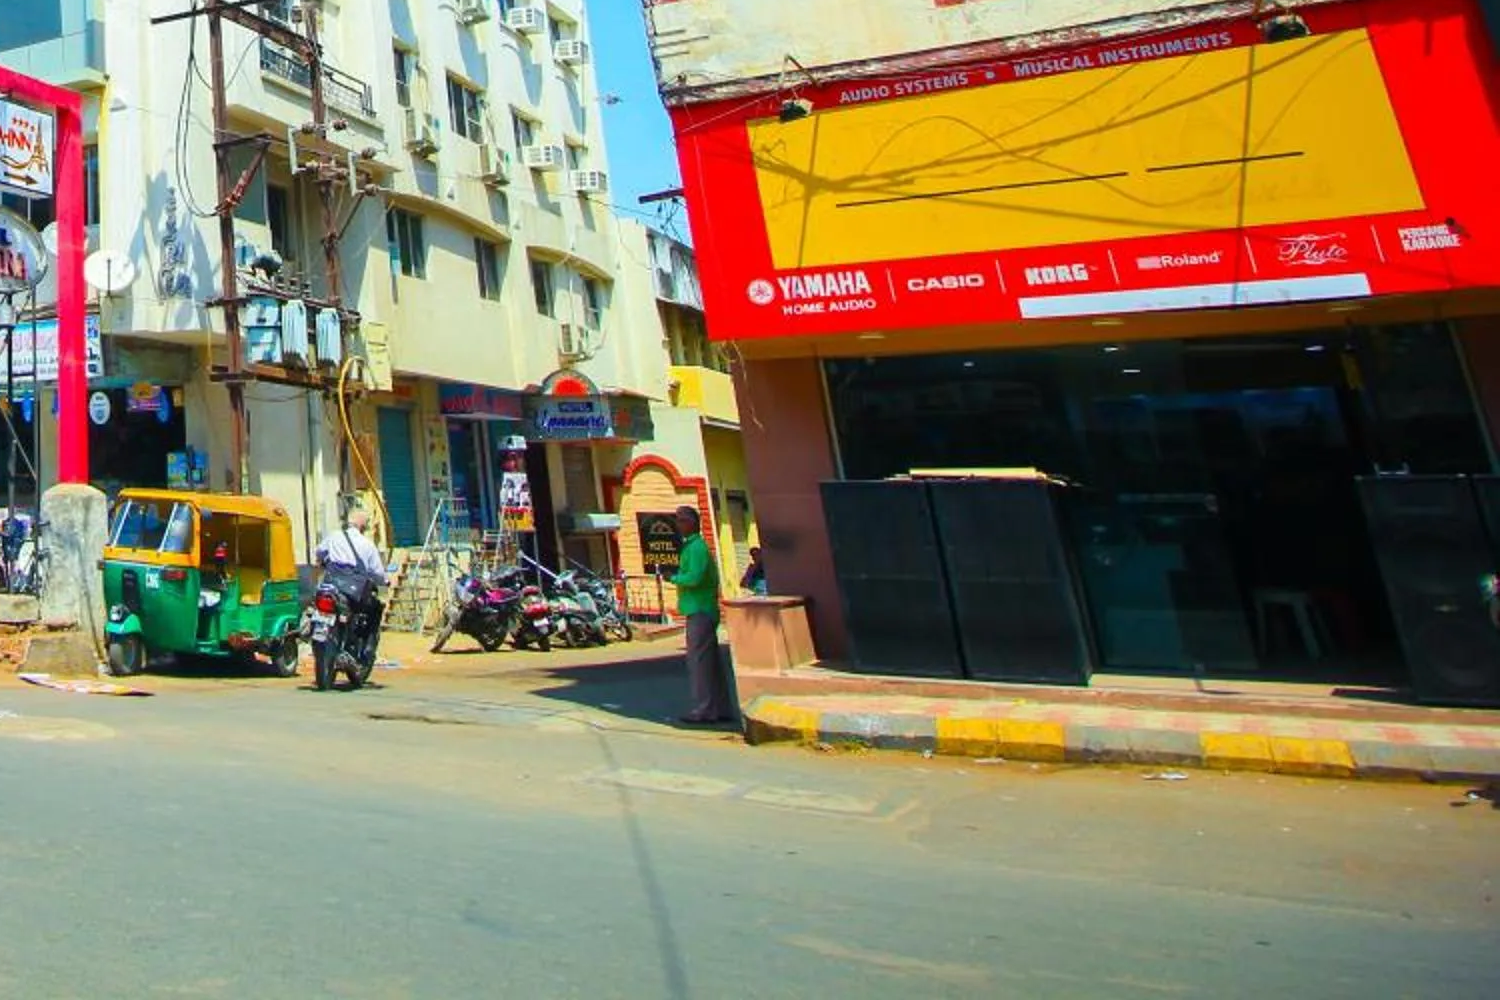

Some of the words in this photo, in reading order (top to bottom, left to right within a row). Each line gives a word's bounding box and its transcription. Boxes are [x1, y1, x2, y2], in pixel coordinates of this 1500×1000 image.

[1013, 55, 1095, 78] MUSICAL
[1099, 32, 1233, 65] INSTRUMENTS
[839, 84, 890, 104] AUDIO
[895, 72, 969, 96] SYSTEMS
[1402, 234, 1462, 252] KARAOKE
[1161, 251, 1221, 268] Roland
[907, 274, 984, 291] CASIO
[1025, 263, 1088, 286] KORG
[777, 270, 872, 300] YAMAHA
[783, 301, 825, 316] HOME
[829, 298, 876, 312] AUDIO
